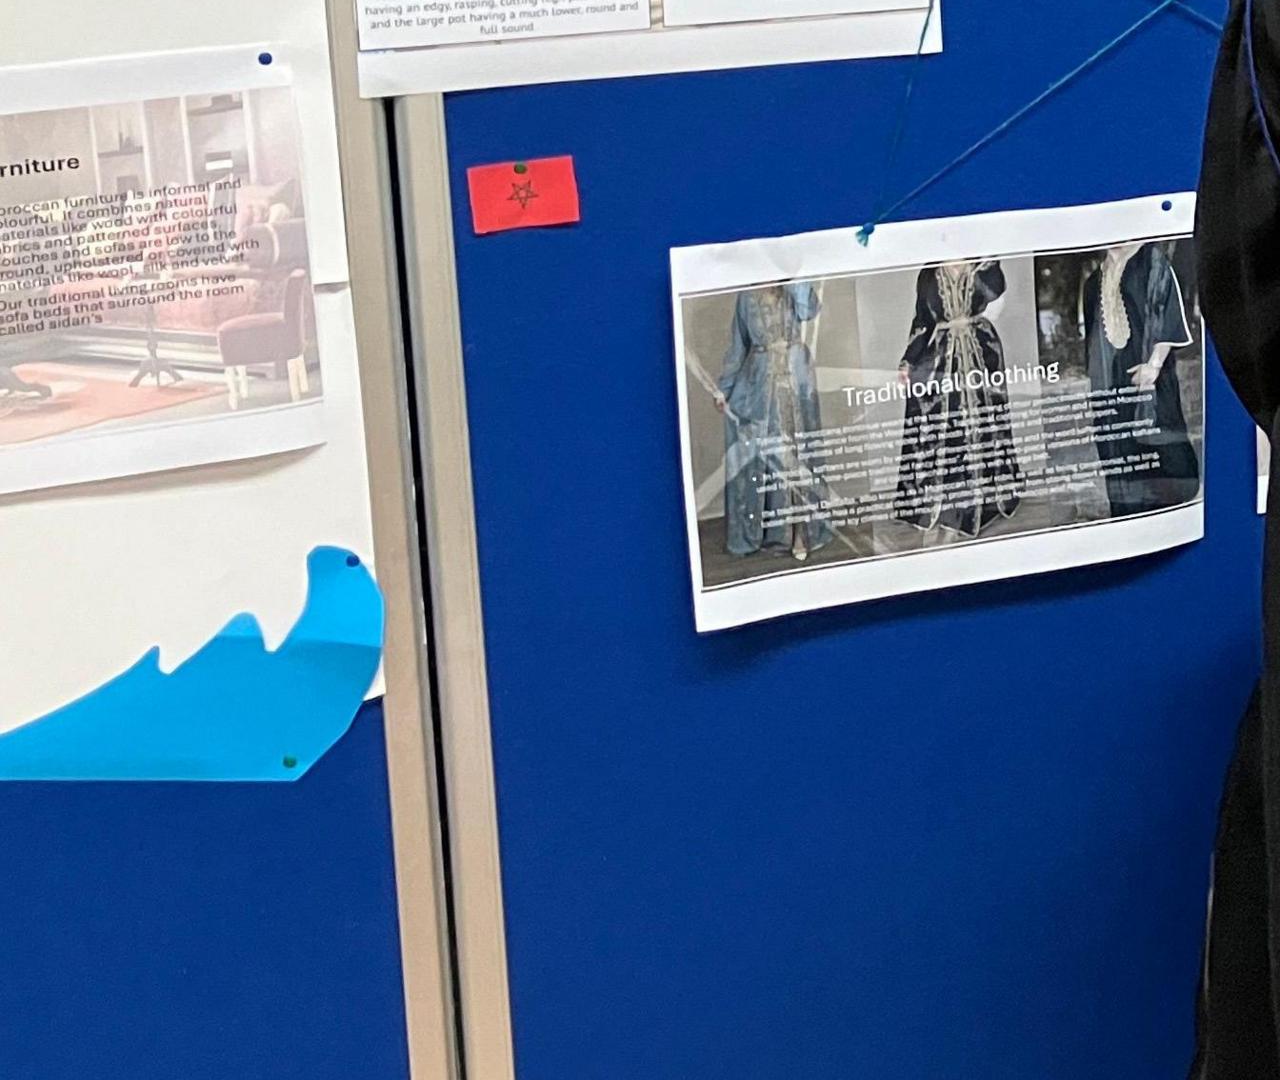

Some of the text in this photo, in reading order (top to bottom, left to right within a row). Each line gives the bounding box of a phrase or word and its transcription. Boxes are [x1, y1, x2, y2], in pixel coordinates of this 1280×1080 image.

[364, 4, 403, 18] having
[406, 3, 420, 13] an
[479, 21, 534, 35] full sound
[64, 191, 128, 208] furniture
[77, 201, 151, 219] combines
[155, 194, 207, 209] natural
[92, 215, 132, 230] wood
[137, 211, 167, 224] with
[171, 203, 237, 220] colourful
[44, 235, 72, 248] and
[77, 226, 149, 245] patterned
[62, 245, 90, 259] and
[94, 240, 135, 254] sofas
[138, 238, 162, 249] are
[166, 232, 192, 245] low
[195, 231, 209, 242] to
[213, 228, 236, 240] the
[53, 252, 143, 274] upholstered
[230, 238, 259, 251] with
[27, 286, 105, 307] traditional
[151, 277, 197, 291] rooms
[201, 270, 236, 285] have
[33, 304, 70, 319] beds
[74, 300, 104, 314] that
[107, 291, 175, 309] surround
[179, 288, 202, 300] the
[206, 285, 244, 297] room
[842, 361, 1060, 407] Traditional Clothing
